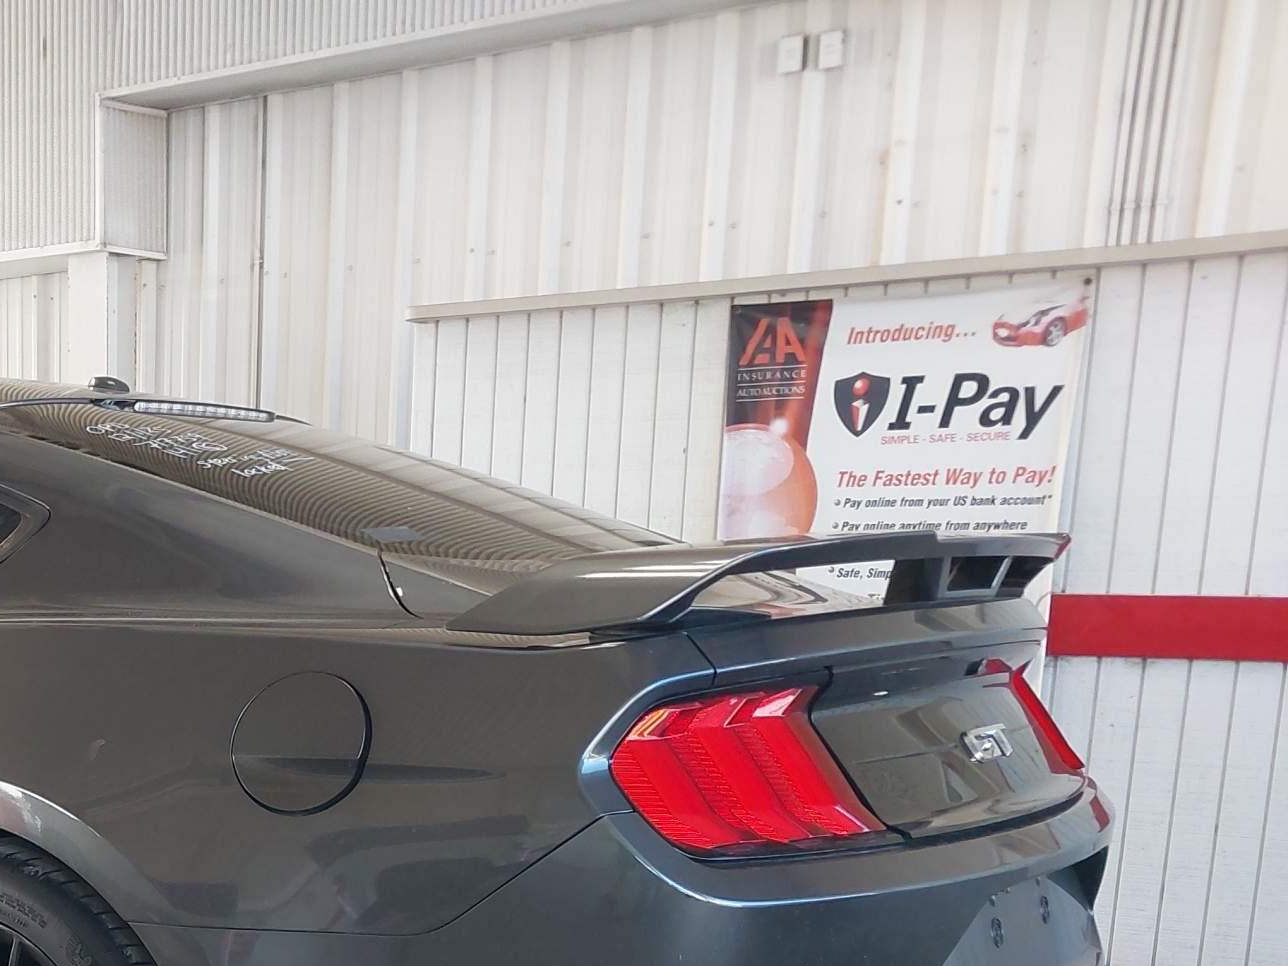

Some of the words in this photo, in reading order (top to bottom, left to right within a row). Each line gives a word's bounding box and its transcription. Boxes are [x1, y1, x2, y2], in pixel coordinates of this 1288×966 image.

[846, 321, 977, 345] Introducing...
[737, 369, 807, 381] INSURANCE
[886, 371, 1065, 440] I-Pay
[880, 434, 920, 445] SIMPLE
[928, 432, 957, 443] SAFE
[966, 431, 1012, 442] SECURE
[838, 470, 868, 488] The
[872, 469, 940, 487] Fastest
[945, 467, 983, 488] Way
[988, 467, 1007, 484] to
[1012, 465, 1056, 487] Pay!
[843, 498, 862, 510] Pay
[864, 497, 897, 508] online
[899, 496, 924, 507] from
[926, 498, 951, 509] your
[953, 495, 968, 506] US
[970, 495, 997, 506] bank
[863, 521, 896, 531] online
[944, 520, 971, 530] from
[973, 520, 1028, 532] anywhere
[836, 567, 863, 580] Safe,
